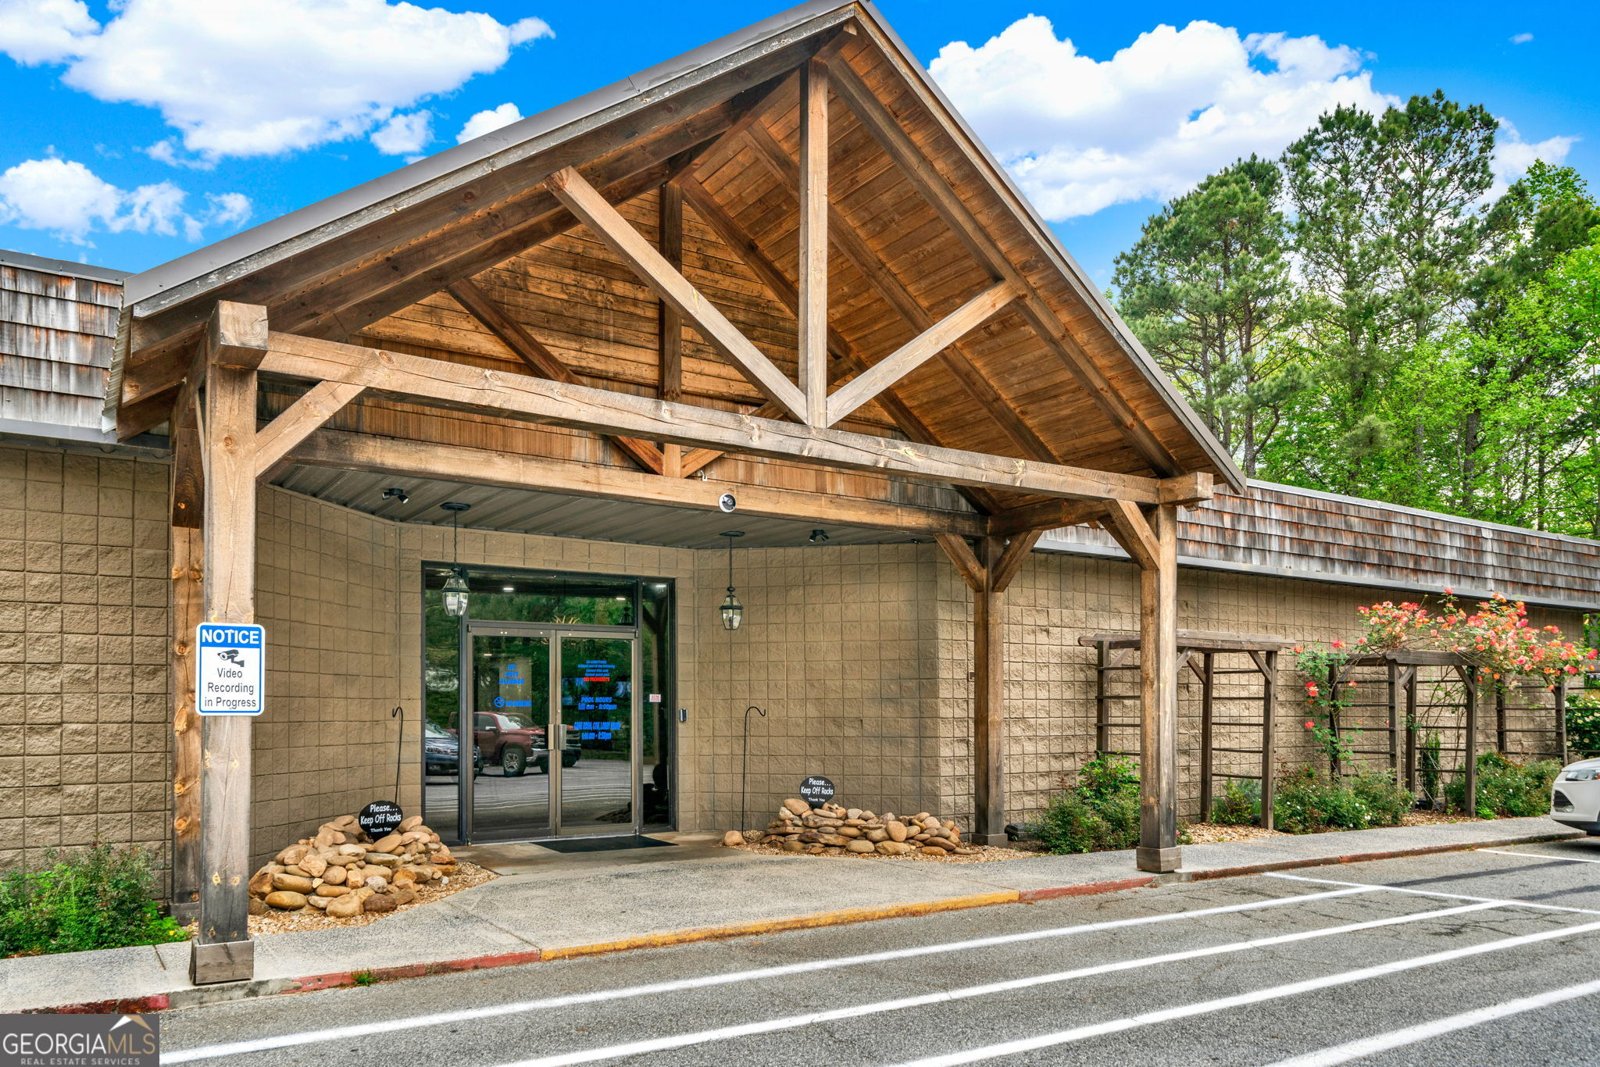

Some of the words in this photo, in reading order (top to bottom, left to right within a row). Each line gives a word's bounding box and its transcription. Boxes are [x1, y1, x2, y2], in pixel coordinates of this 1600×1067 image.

[202, 629, 260, 644] NOTICE
[217, 668, 243, 678] Video
[207, 682, 254, 695] Recording
[204, 697, 213, 707] in
[216, 697, 257, 709] Progress
[809, 777, 831, 786] Please...
[801, 786, 811, 796] Keep
[812, 786, 820, 795] Off
[821, 786, 834, 795] Rocks
[370, 804, 398, 812] Please...
[360, 815, 374, 826] Keep
[375, 813, 386, 824] Off
[386, 812, 402, 822] Rocks
